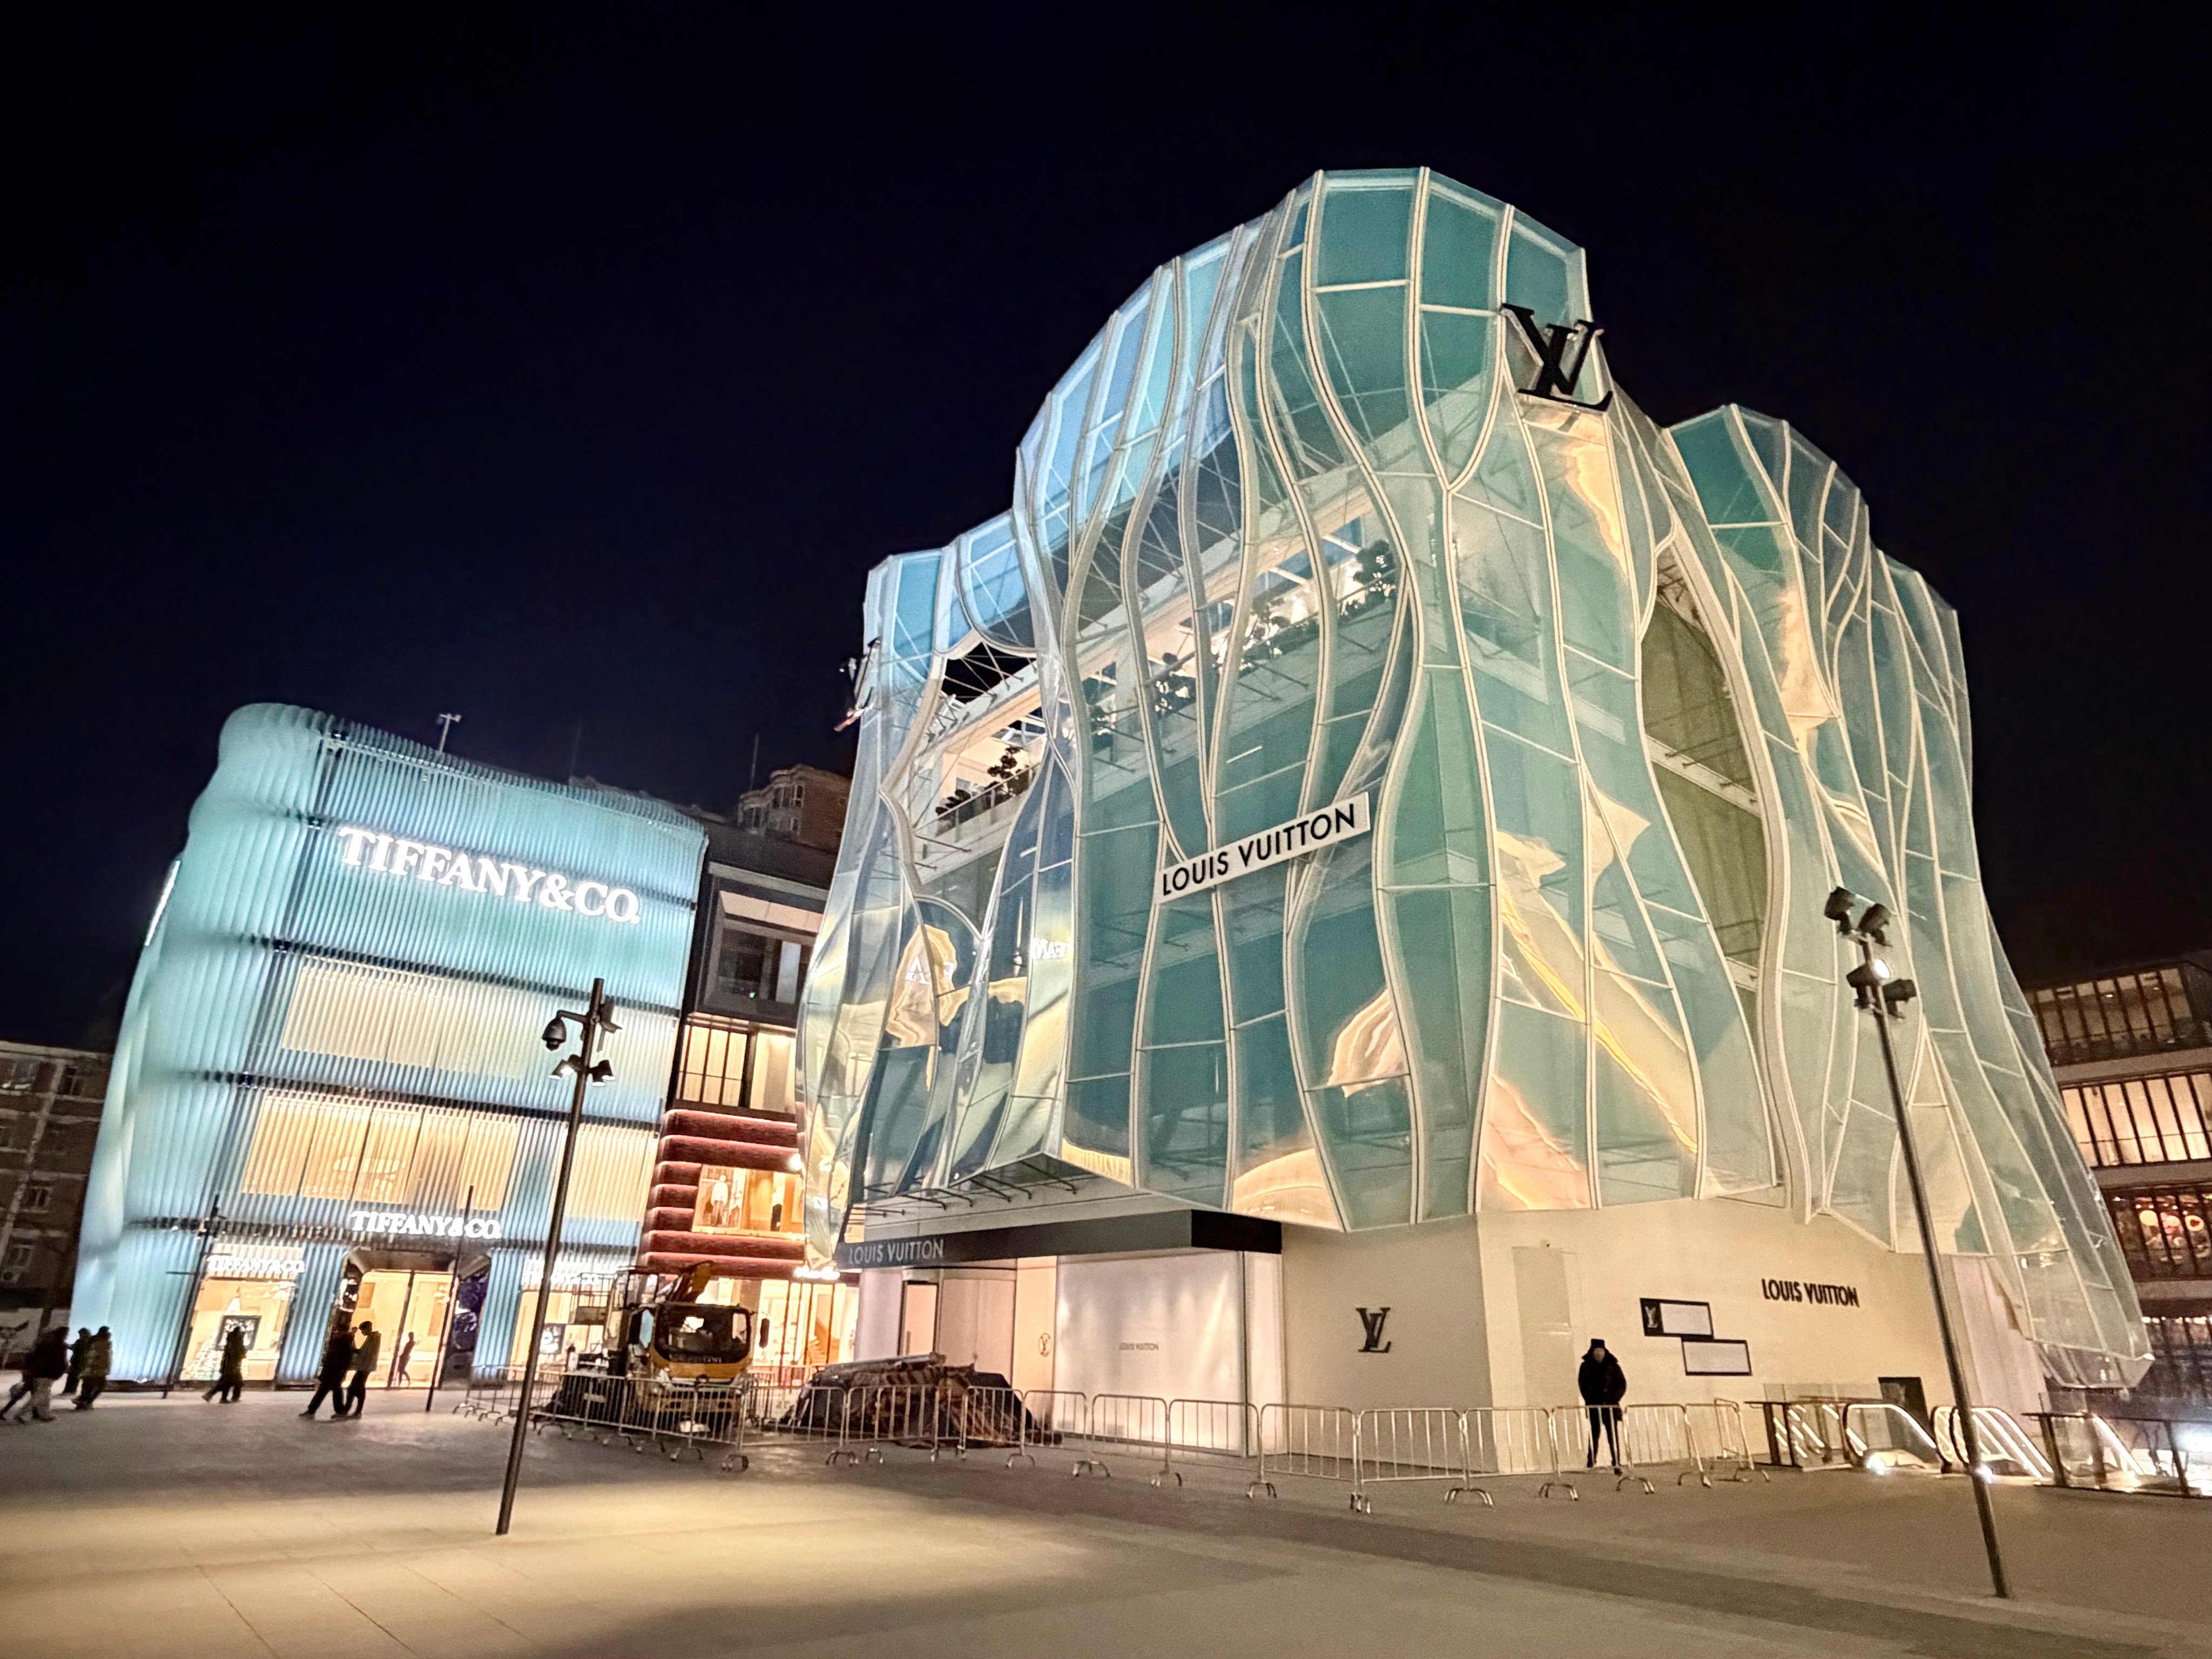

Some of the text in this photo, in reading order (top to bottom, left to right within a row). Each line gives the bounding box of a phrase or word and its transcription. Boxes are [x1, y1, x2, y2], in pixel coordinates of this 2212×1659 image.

[339, 827, 640, 924] TIFFANY&CO.
[1163, 804, 1355, 896] LOUIS VUITTON
[849, 1239, 944, 1265] LOUIS VUITTON
[1762, 1278, 1860, 1307] LOUIS VUITTON
